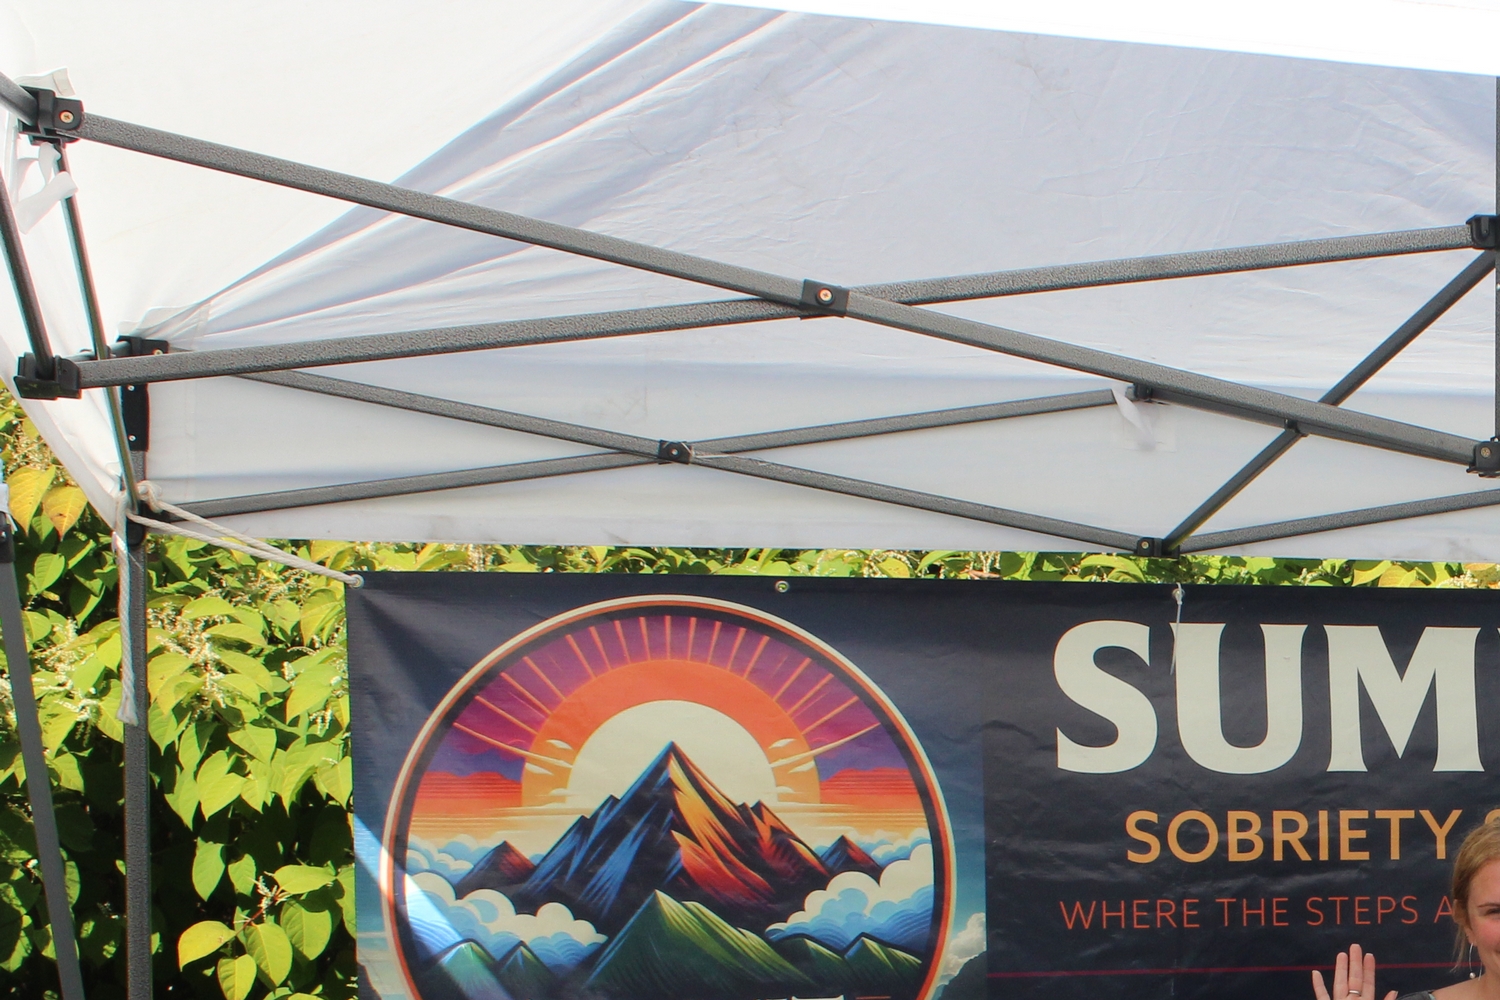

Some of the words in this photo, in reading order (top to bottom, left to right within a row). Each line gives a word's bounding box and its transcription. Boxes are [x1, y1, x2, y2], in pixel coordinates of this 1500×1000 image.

[1125, 809, 1463, 864] SOBRIETY
[1061, 899, 1201, 931] WHERE
[1214, 897, 1289, 928] THE
[1306, 895, 1420, 926] STEPS
